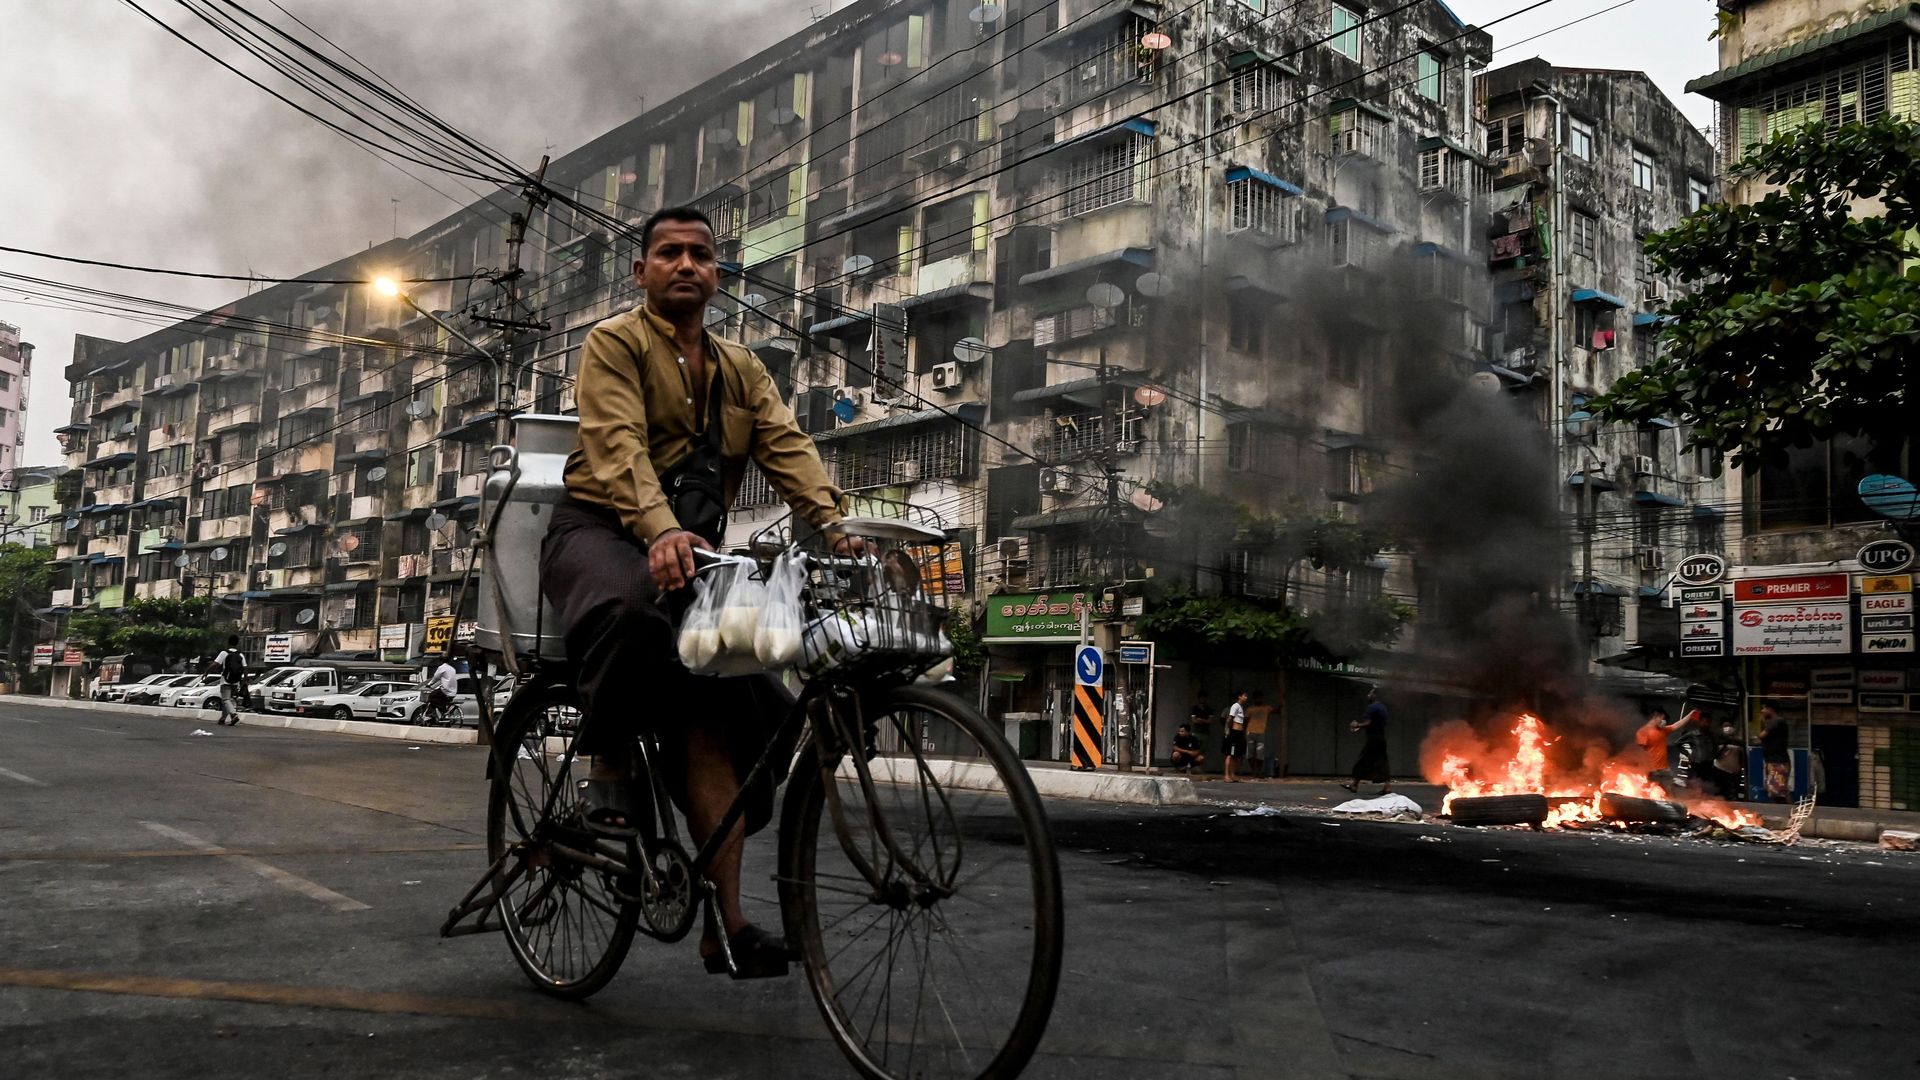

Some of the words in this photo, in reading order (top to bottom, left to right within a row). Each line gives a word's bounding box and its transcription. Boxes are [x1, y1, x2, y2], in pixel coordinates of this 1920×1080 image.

[1864, 548, 1907, 564] UPG
[1682, 562, 1719, 577] UPG
[1766, 582, 1811, 594] PREMIER
[1684, 590, 1715, 599] ORIENT
[1866, 598, 1906, 609] EAGLE
[1685, 645, 1718, 653] ORIENT
